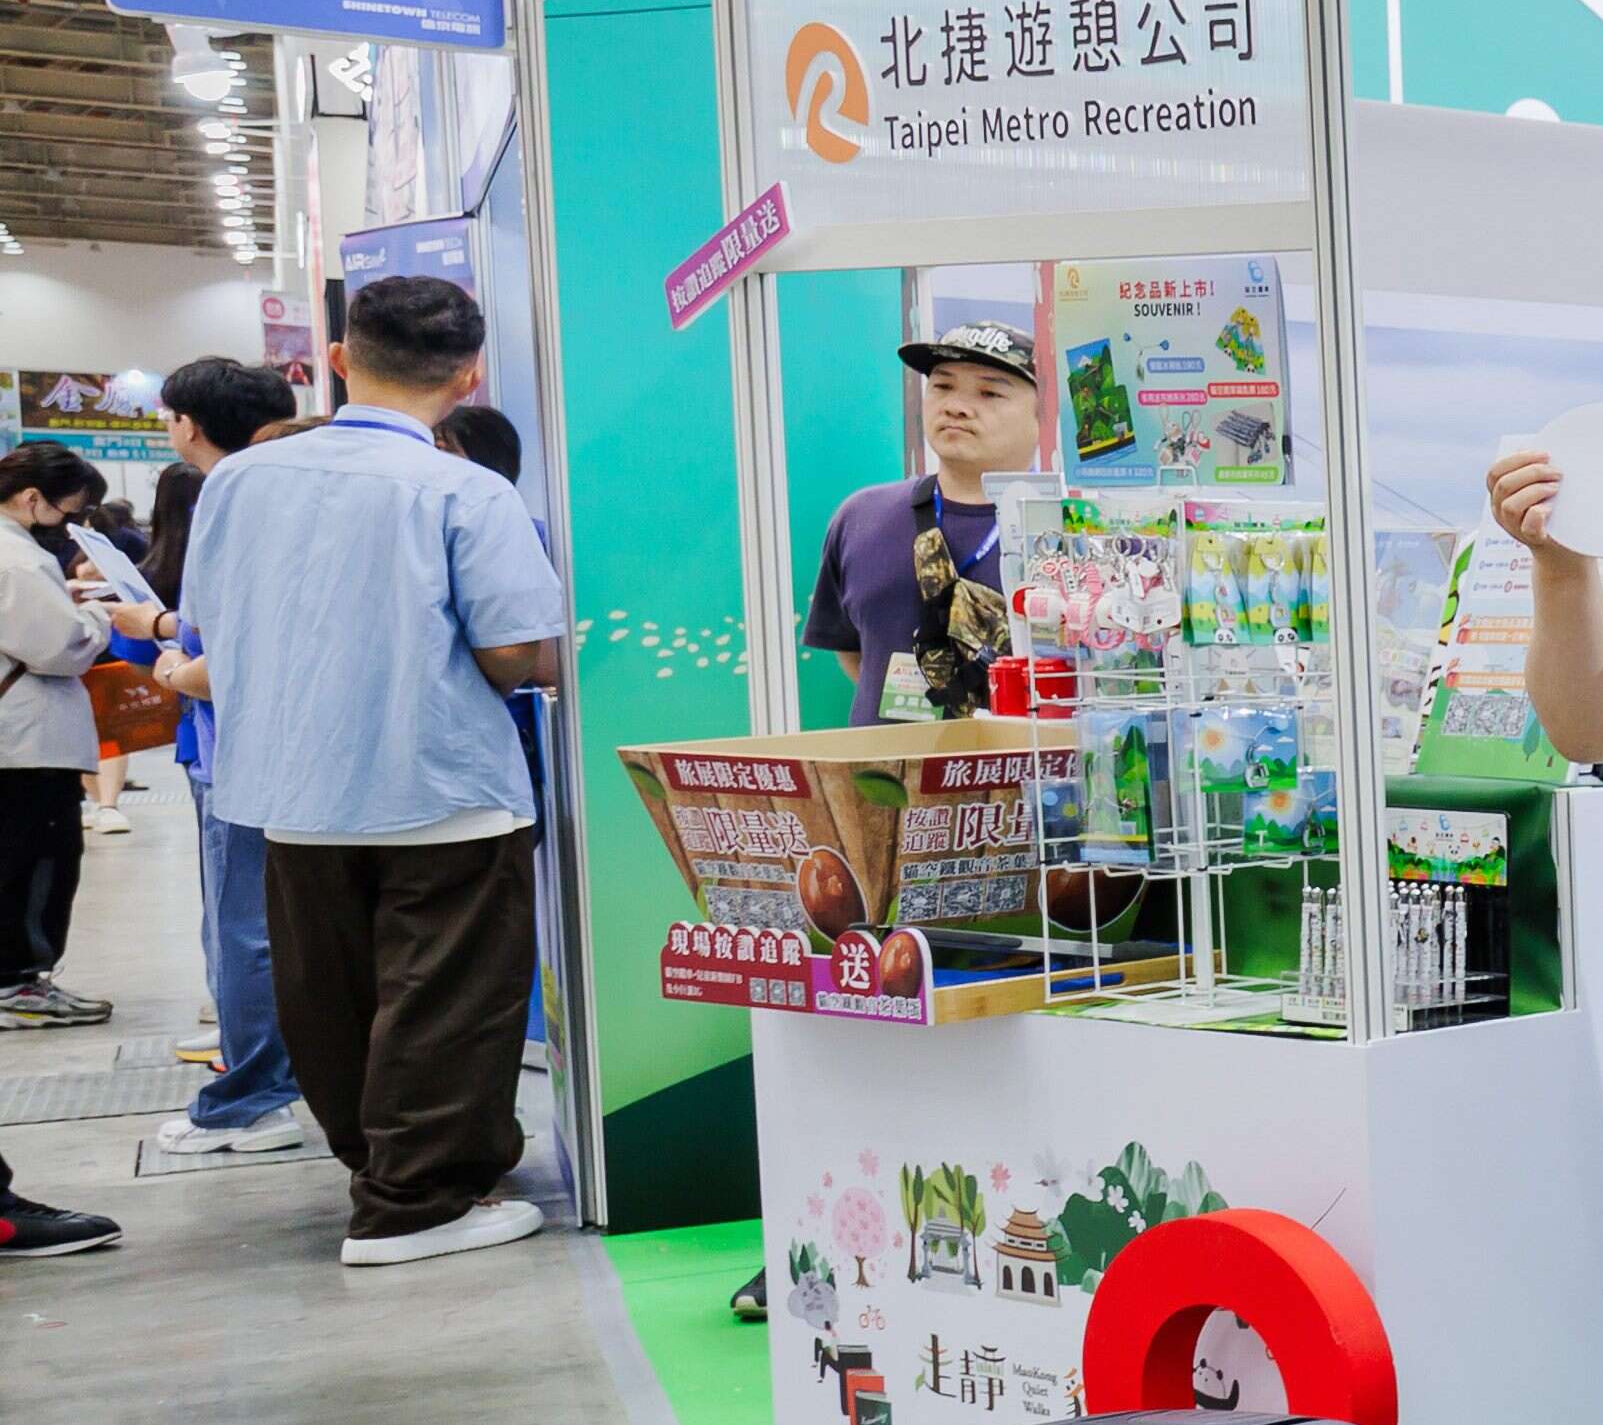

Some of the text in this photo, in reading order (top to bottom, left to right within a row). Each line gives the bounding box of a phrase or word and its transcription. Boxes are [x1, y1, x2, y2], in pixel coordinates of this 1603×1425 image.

[885, 88, 1257, 158] Taipei Metro Recreation
[674, 758, 798, 792] 旅展限定優惠
[701, 807, 811, 858] 限量送
[671, 927, 803, 966] 現場按讚追蹤
[838, 942, 871, 990] 送
